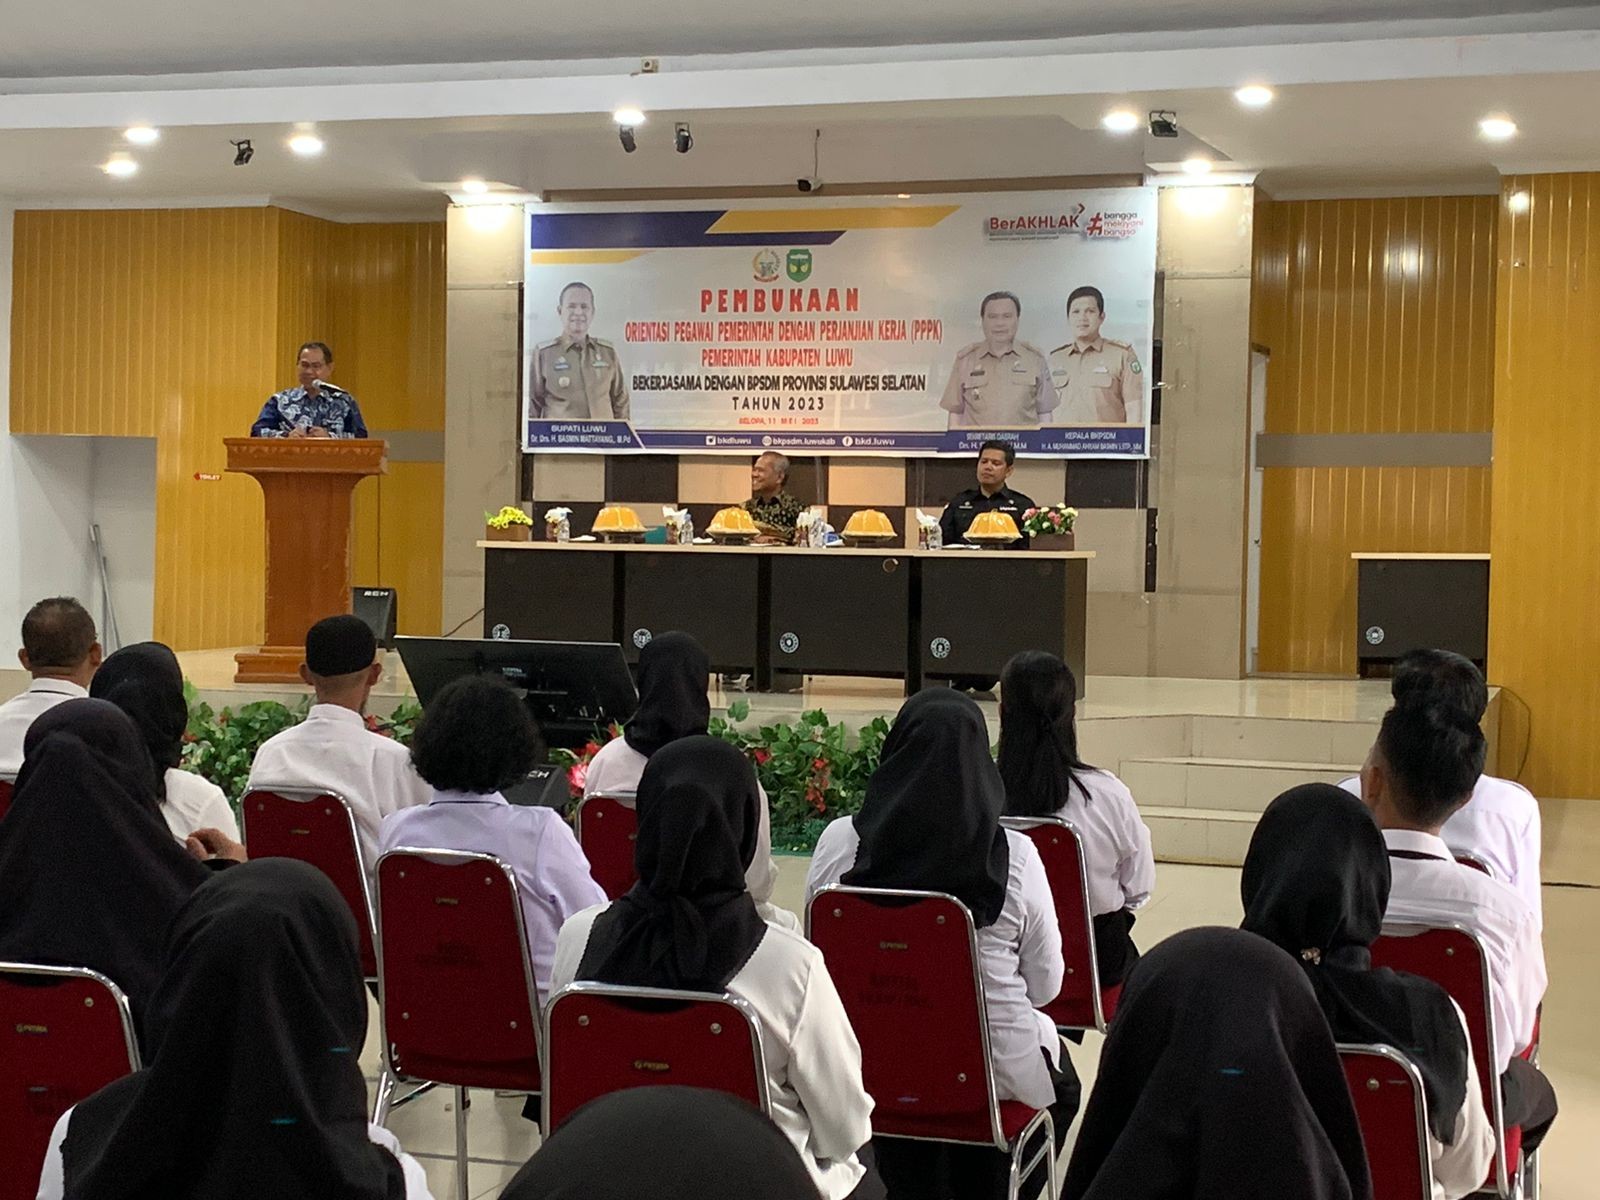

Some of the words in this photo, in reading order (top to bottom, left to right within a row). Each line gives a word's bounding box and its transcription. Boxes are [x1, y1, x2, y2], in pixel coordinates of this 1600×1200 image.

[989, 214, 1080, 230] BerAKHLAK
[1104, 211, 1138, 220] bangga
[1104, 228, 1136, 237] bangsa
[701, 288, 859, 313] PEMBUKAAN
[625, 322, 670, 343] ORIENTASI
[674, 321, 713, 342] PEGAWAI
[718, 321, 774, 342] PEMERINTAH
[779, 321, 815, 342] DENGAN
[820, 320, 874, 341] PERJANJIAN
[878, 320, 907, 341] KERJA
[911, 319, 943, 344] (PPPK)
[702, 349, 761, 368] PEMERINTAH
[766, 349, 820, 367] KABUPATEN
[826, 349, 853, 367] LUWU
[633, 375, 701, 391] BEKERJASAMA
[704, 375, 745, 391] DENGAN
[747, 375, 780, 391] BPSDM
[782, 375, 827, 391] PROVINSI
[829, 375, 880, 391] SULAWESI
[882, 375, 926, 391] SELATAN
[732, 397, 781, 411] TAHUN
[788, 396, 825, 410] 2023
[1065, 432, 1090, 440] KEPALA
